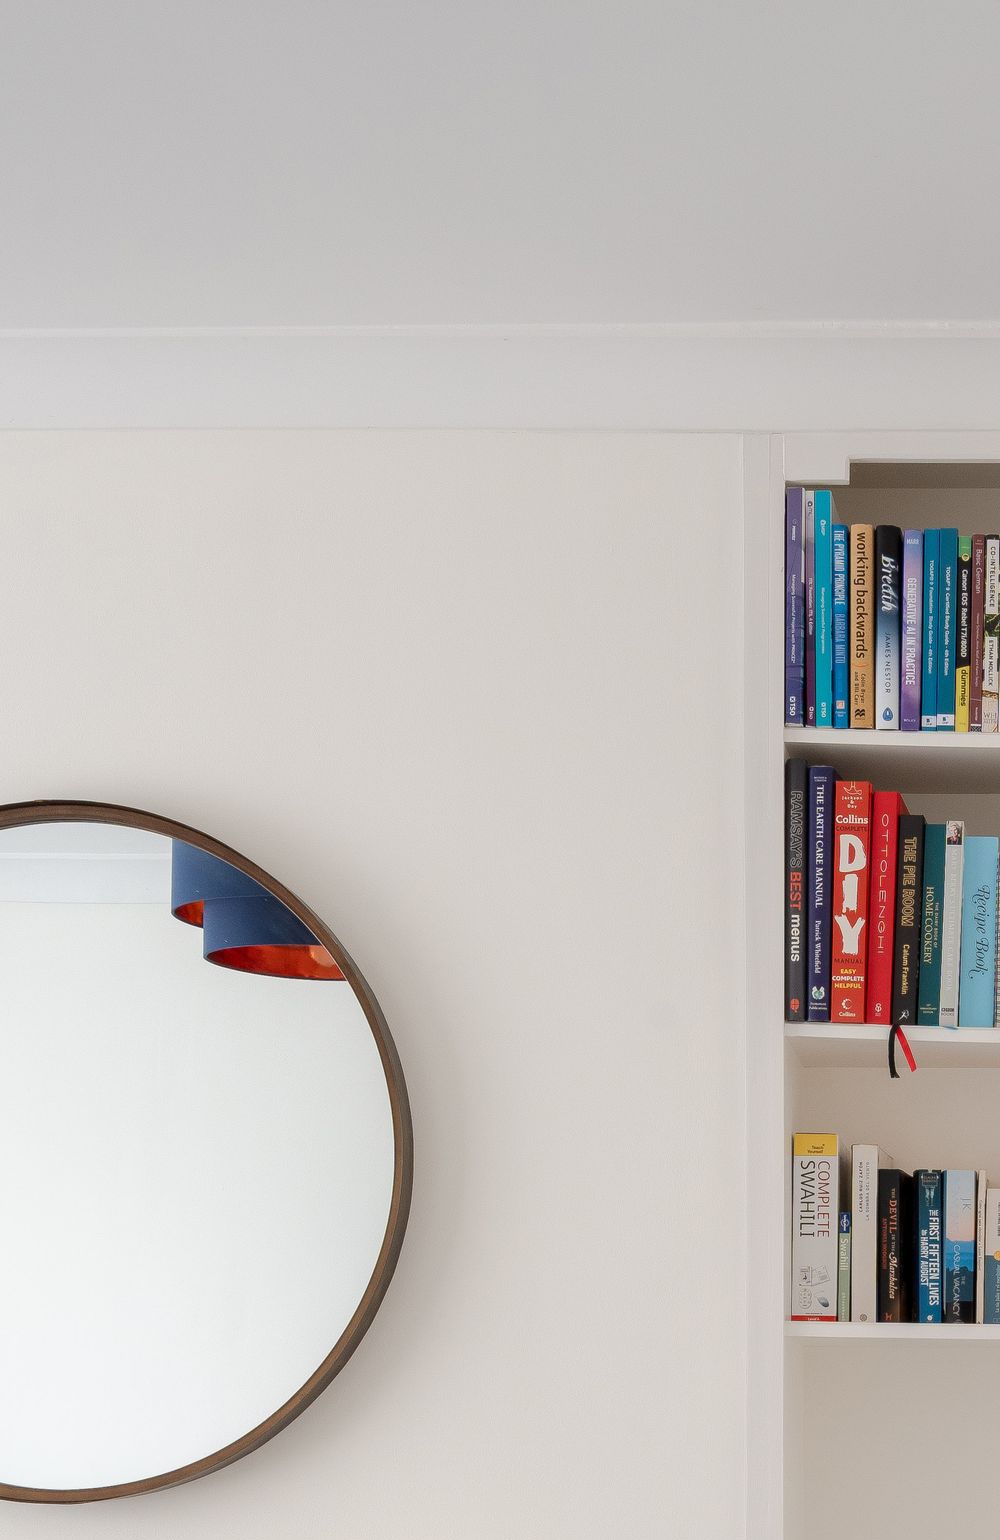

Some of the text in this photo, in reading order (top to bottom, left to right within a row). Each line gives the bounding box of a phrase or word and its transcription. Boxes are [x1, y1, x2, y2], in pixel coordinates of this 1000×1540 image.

[834, 530, 845, 605] THE PYRAMID PRINCIPLE
[881, 554, 898, 612] Breath
[854, 532, 868, 658] working backwards
[907, 578, 917, 624] GENERATIVE
[835, 614, 846, 663] BARBARA MINTO
[907, 637, 916, 645] IN
[906, 648, 915, 685] PRACTICE
[960, 670, 968, 706] dummies
[816, 807, 824, 840] EARTH
[836, 815, 868, 823] Collins
[790, 791, 803, 961] RAMSAY'S BEST menus
[834, 834, 867, 955] DIY
[877, 814, 889, 953] OTTOLENGHI
[901, 837, 917, 926] THE PIE ROOM
[923, 887, 934, 964] HOME COOKERY
[970, 885, 990, 979] Recipe Book
[901, 967, 909, 994] Franklin
[800, 1161, 815, 1237] SWAHILI
[817, 1161, 830, 1237] COMPLETE
[930, 1218, 939, 1241] FIRST
[840, 1239, 848, 1270] Swahili
[929, 1244, 939, 1279] FIFTEEN
[929, 1283, 939, 1305] LIVES
